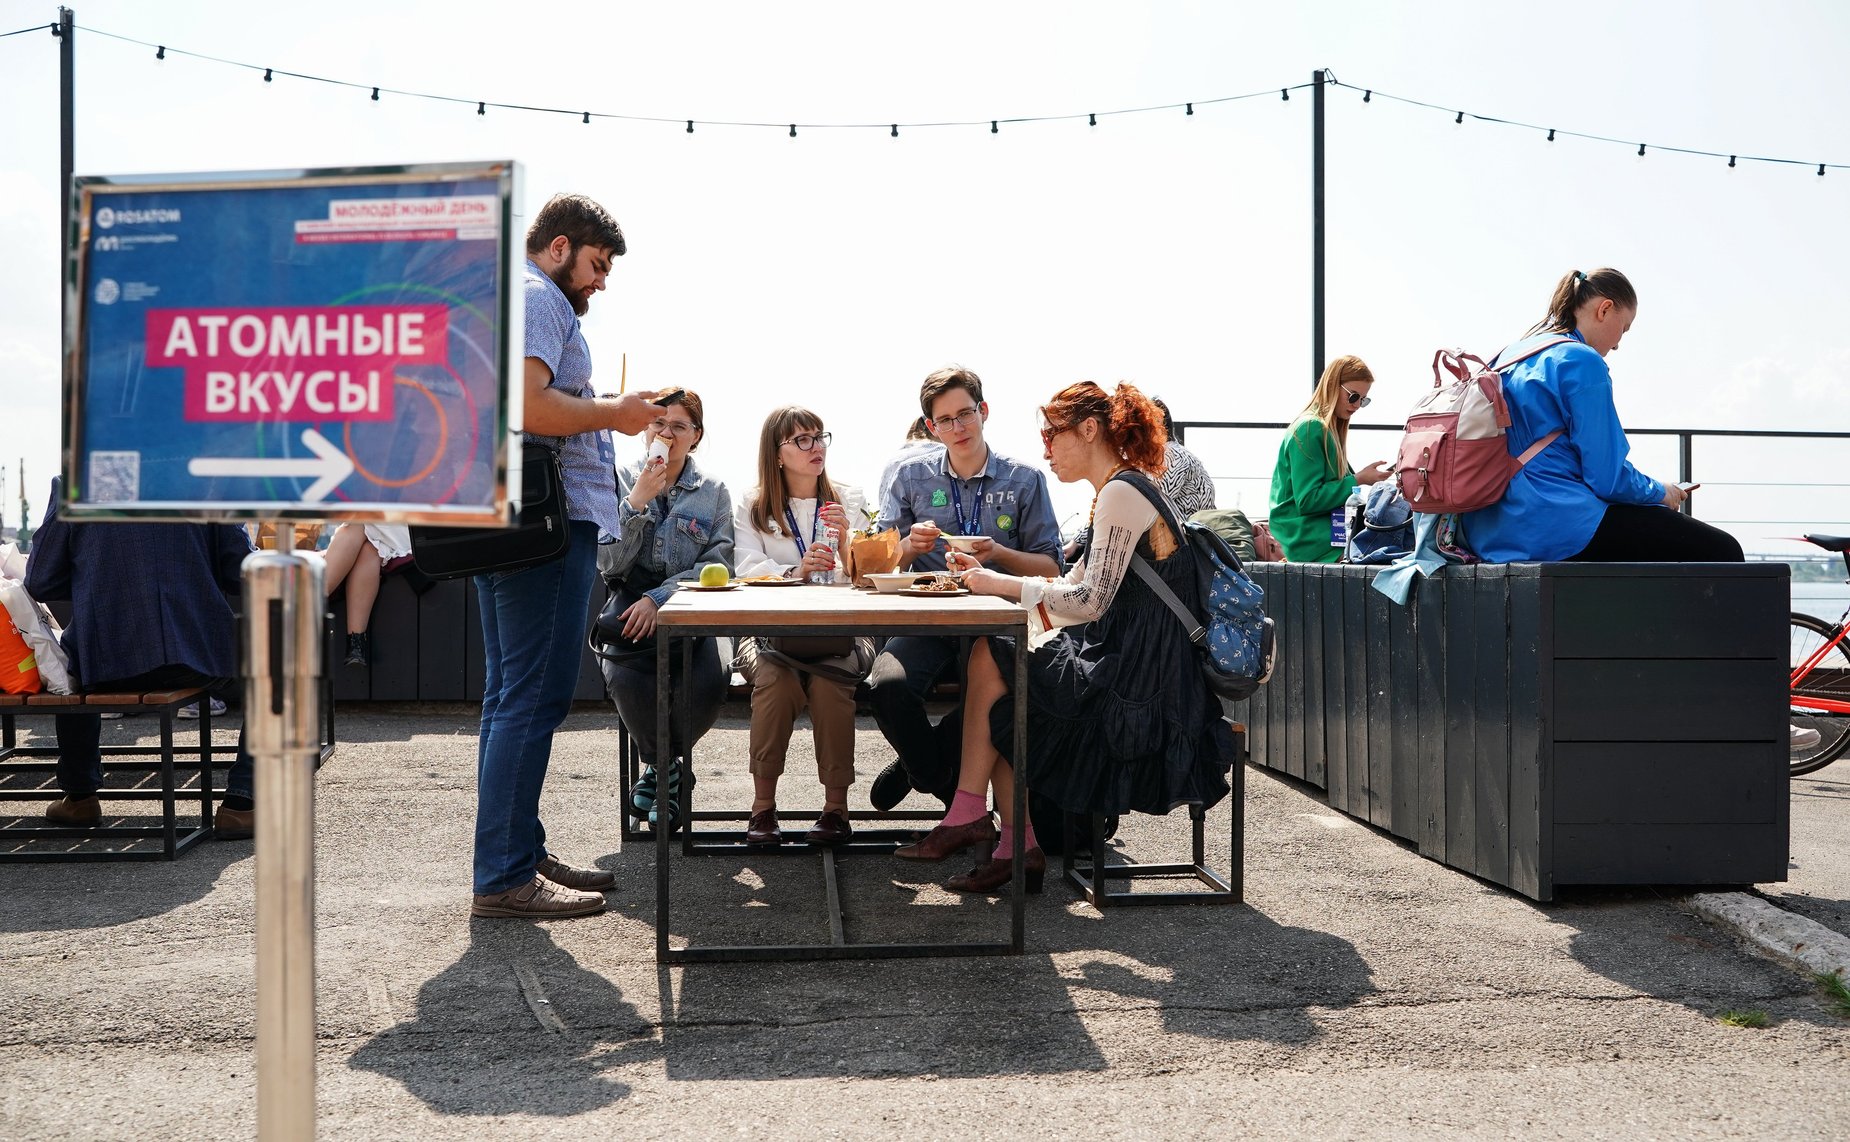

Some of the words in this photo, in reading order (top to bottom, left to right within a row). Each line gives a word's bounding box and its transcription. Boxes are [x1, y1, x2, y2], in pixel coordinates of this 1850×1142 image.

[449, 201, 488, 215] ДЕНЬ
[163, 312, 426, 358] АТОМНЫЕ
[204, 369, 381, 414] ВКУСЫ
